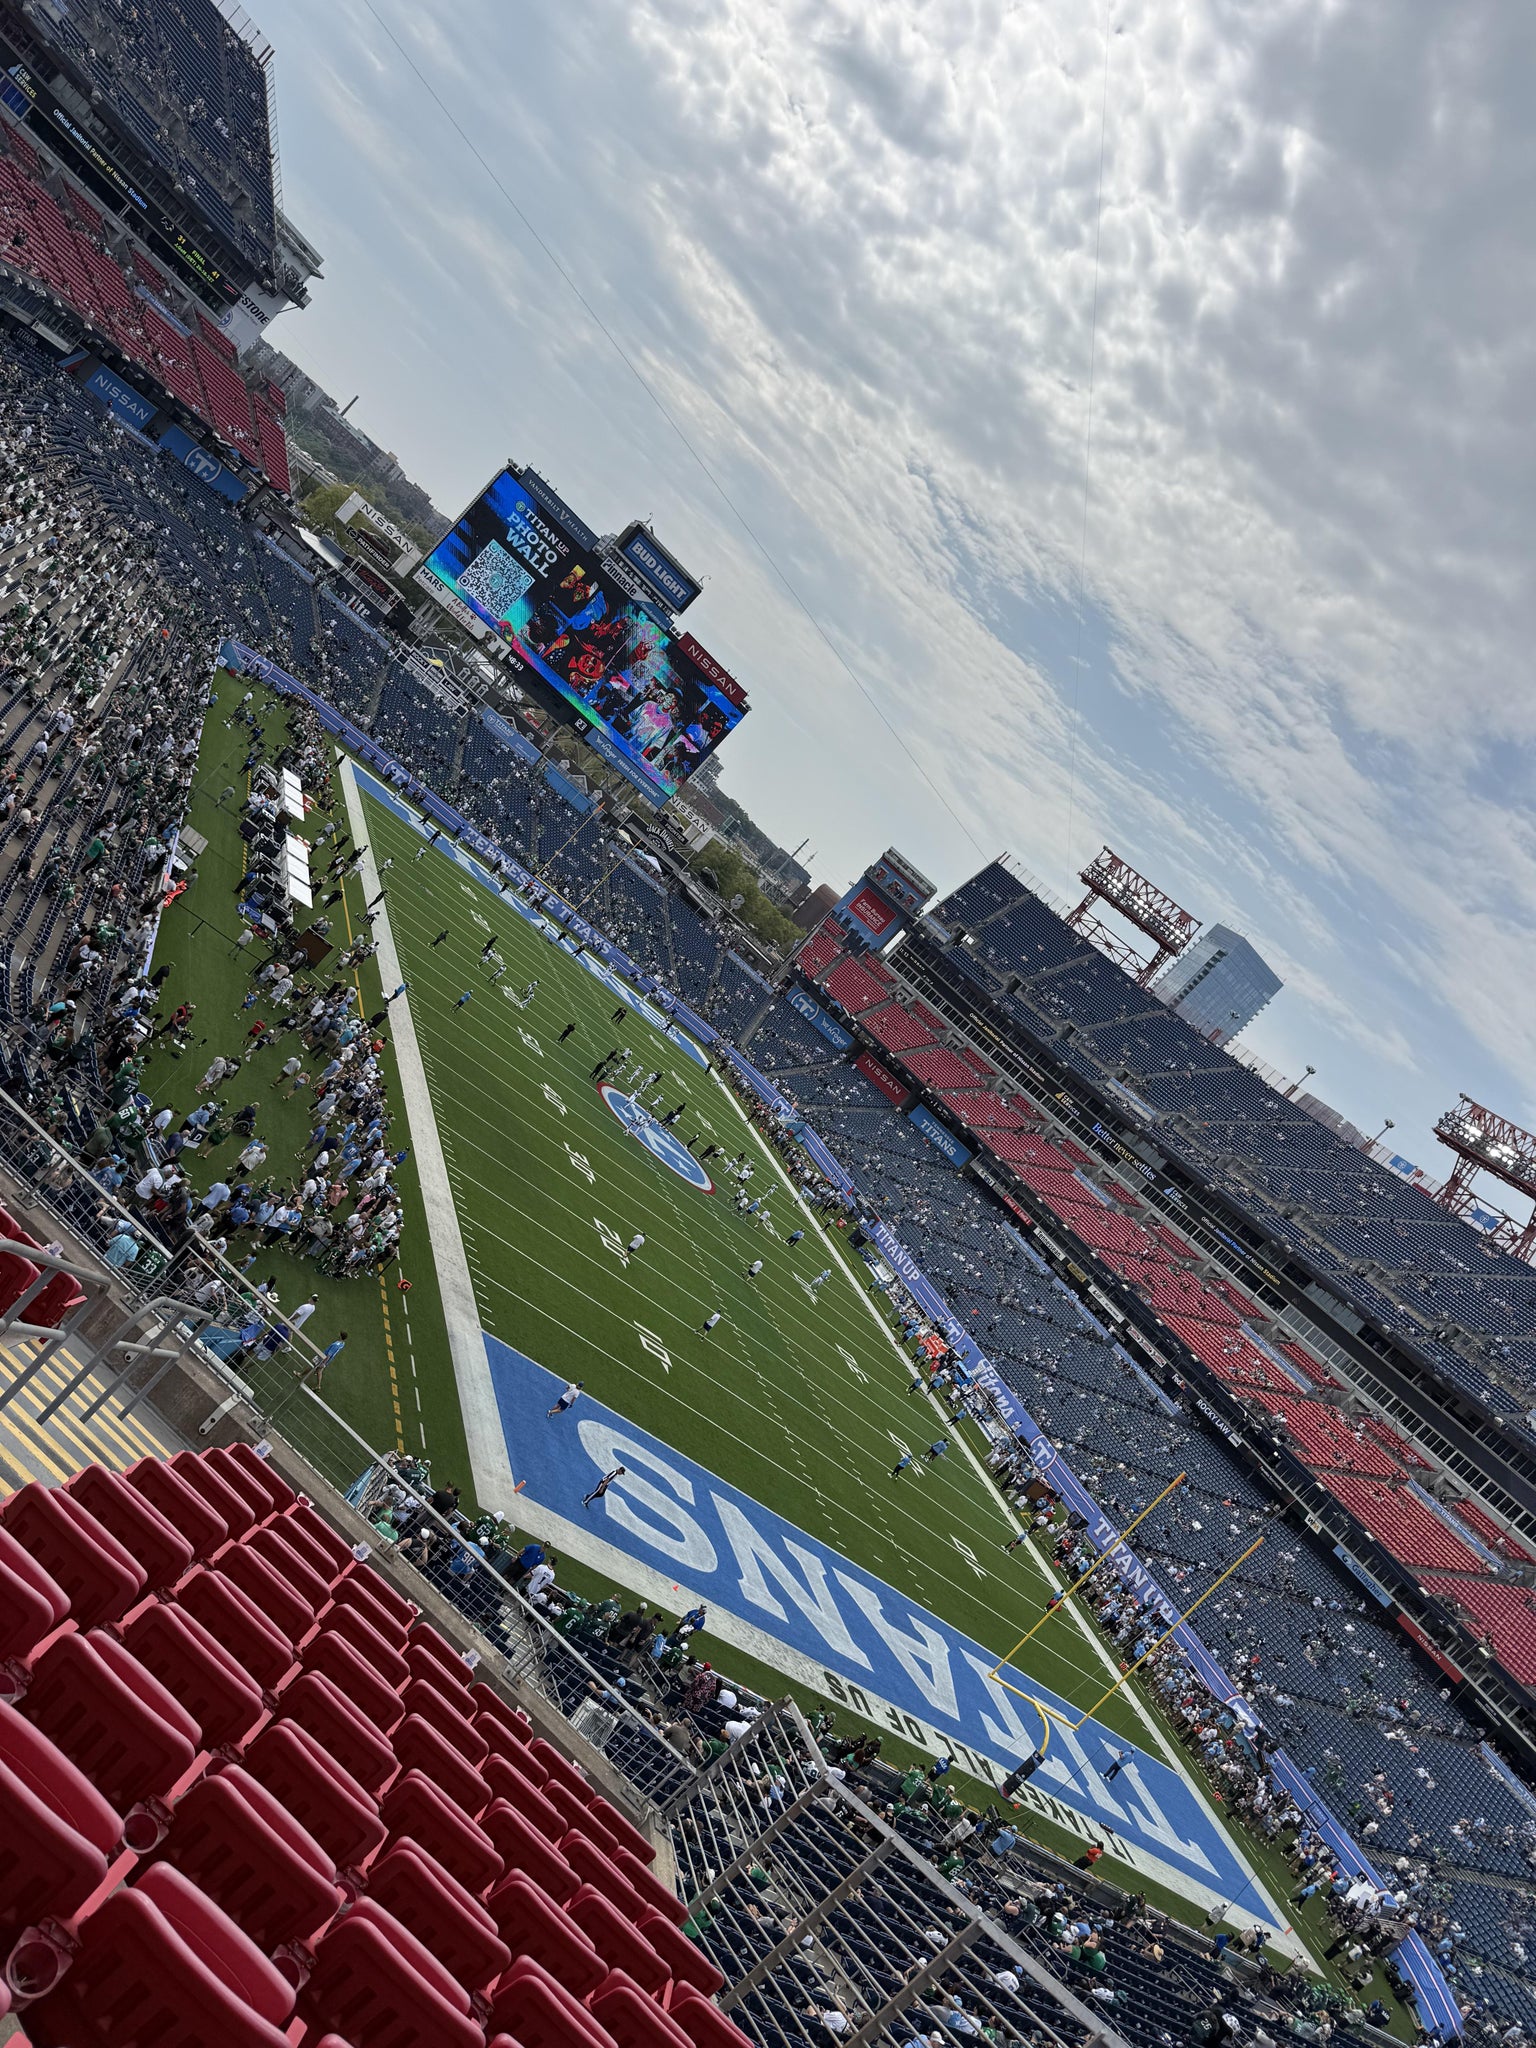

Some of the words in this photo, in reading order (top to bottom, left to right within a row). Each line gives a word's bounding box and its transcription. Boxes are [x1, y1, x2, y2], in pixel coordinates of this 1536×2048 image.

[14, 74, 38, 99] SERVICES
[18, 68, 32, 81] C&W
[53, 109, 72, 129] Official
[69, 127, 92, 151] Janitorial
[89, 147, 107, 167] Partner
[105, 165, 114, 174] of
[111, 170, 129, 190] Nissan
[127, 187, 148, 210] Stadium
[94, 374, 150, 421] NISSAN
[361, 503, 413, 553] NISSAN
[528, 479, 560, 512] VANDERBILT
[567, 519, 588, 541] HEALTH
[507, 511, 557, 563] PHOTO
[525, 509, 559, 545] TITAN
[556, 541, 570, 556] UP
[357, 537, 391, 568] PATHFINDER
[506, 527, 550, 578] WALL
[631, 542, 657, 569] BUD
[653, 564, 687, 599] LIGHT
[420, 568, 445, 592] MARS
[602, 559, 637, 597] Pinnacle
[508, 655, 524, 671] 48:33
[687, 644, 738, 697] NISSAN
[601, 743, 617, 757] Kroger
[617, 759, 631, 773] FRESH
[628, 768, 639, 779] FOR
[646, 823, 660, 836] JACK
[665, 823, 686, 842] FRONTIER
[671, 795, 708, 833] NISSAN
[855, 902, 883, 927] INSURANCE
[860, 898, 873, 911] Farm
[827, 1026, 848, 1047] Kroger
[969, 1012, 984, 1027] Official
[982, 1022, 1002, 1042] Janitorial
[999, 1039, 1014, 1055] Partner
[1012, 1051, 1019, 1059] of
[1016, 1055, 1031, 1070] Nissan
[1028, 1065, 1045, 1082] Stadium
[865, 1058, 902, 1095] NISSAN
[921, 1118, 957, 1157] TITANS
[1091, 1122, 1117, 1146] Better
[1112, 1141, 1136, 1164] never
[1131, 1155, 1157, 1181] settles
[875, 1225, 907, 1266] TITAN
[902, 1260, 920, 1281] UP
[1201, 1216, 1216, 1230] Official
[1230, 1240, 1247, 1256] Partner
[1245, 1253, 1252, 1261] of
[1249, 1255, 1265, 1271] Nissan
[1262, 1268, 1281, 1286] Stadium
[1171, 1373, 1186, 1390] FedEx
[1196, 1399, 1218, 1421] ROCKY
[1215, 1419, 1231, 1435] LAW
[1094, 1516, 1148, 1590] TITAN
[1351, 1563, 1383, 1599] Gallagher
[566, 1618, 578, 1630] 6
[577, 1420, 1222, 1881] TITANS
[1417, 1634, 1442, 1661] NISSAN
[824, 1671, 875, 1717] US
[886, 1708, 928, 1747] OF
[934, 1731, 998, 1785] ALL
[1101, 1836, 1136, 1865] IT
